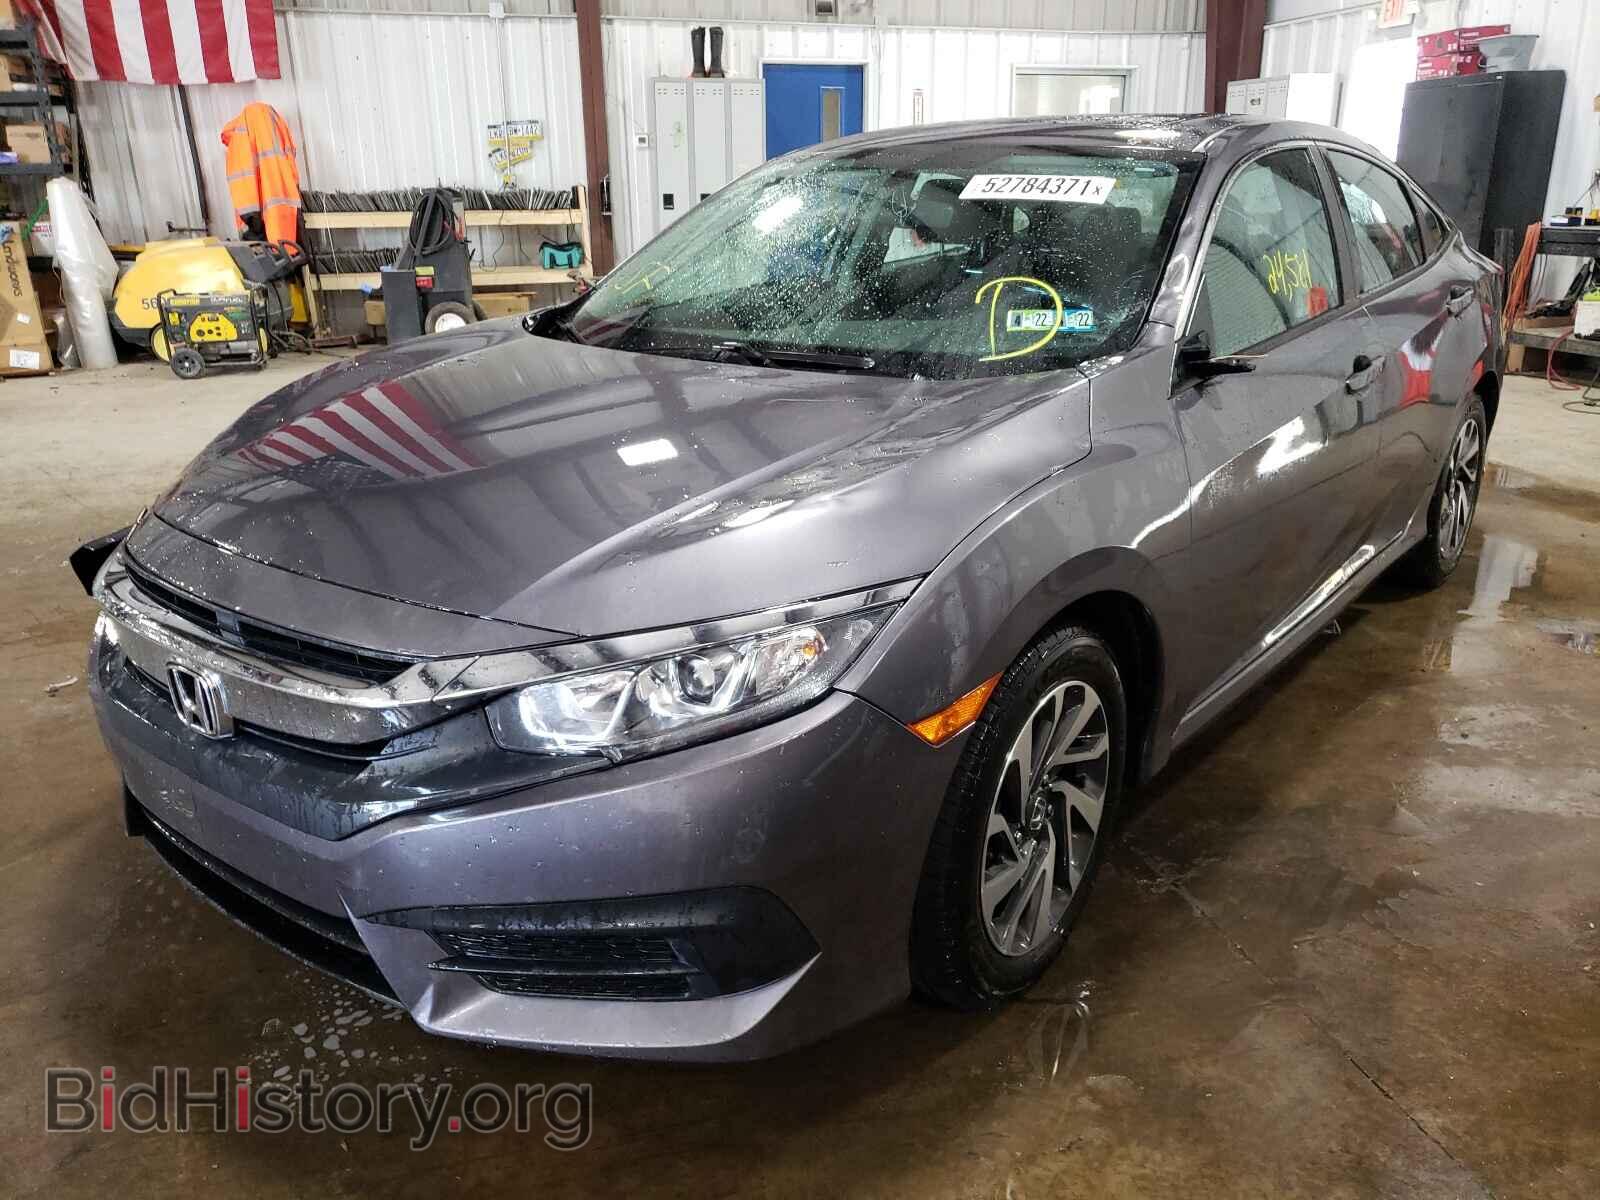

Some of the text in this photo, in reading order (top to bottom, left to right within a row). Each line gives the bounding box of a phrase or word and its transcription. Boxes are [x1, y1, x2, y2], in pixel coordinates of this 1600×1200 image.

[982, 177, 1092, 196] 52784371
[975, 276, 1063, 361] D
[1034, 313, 1047, 326] 22
[1078, 312, 1090, 326] 22
